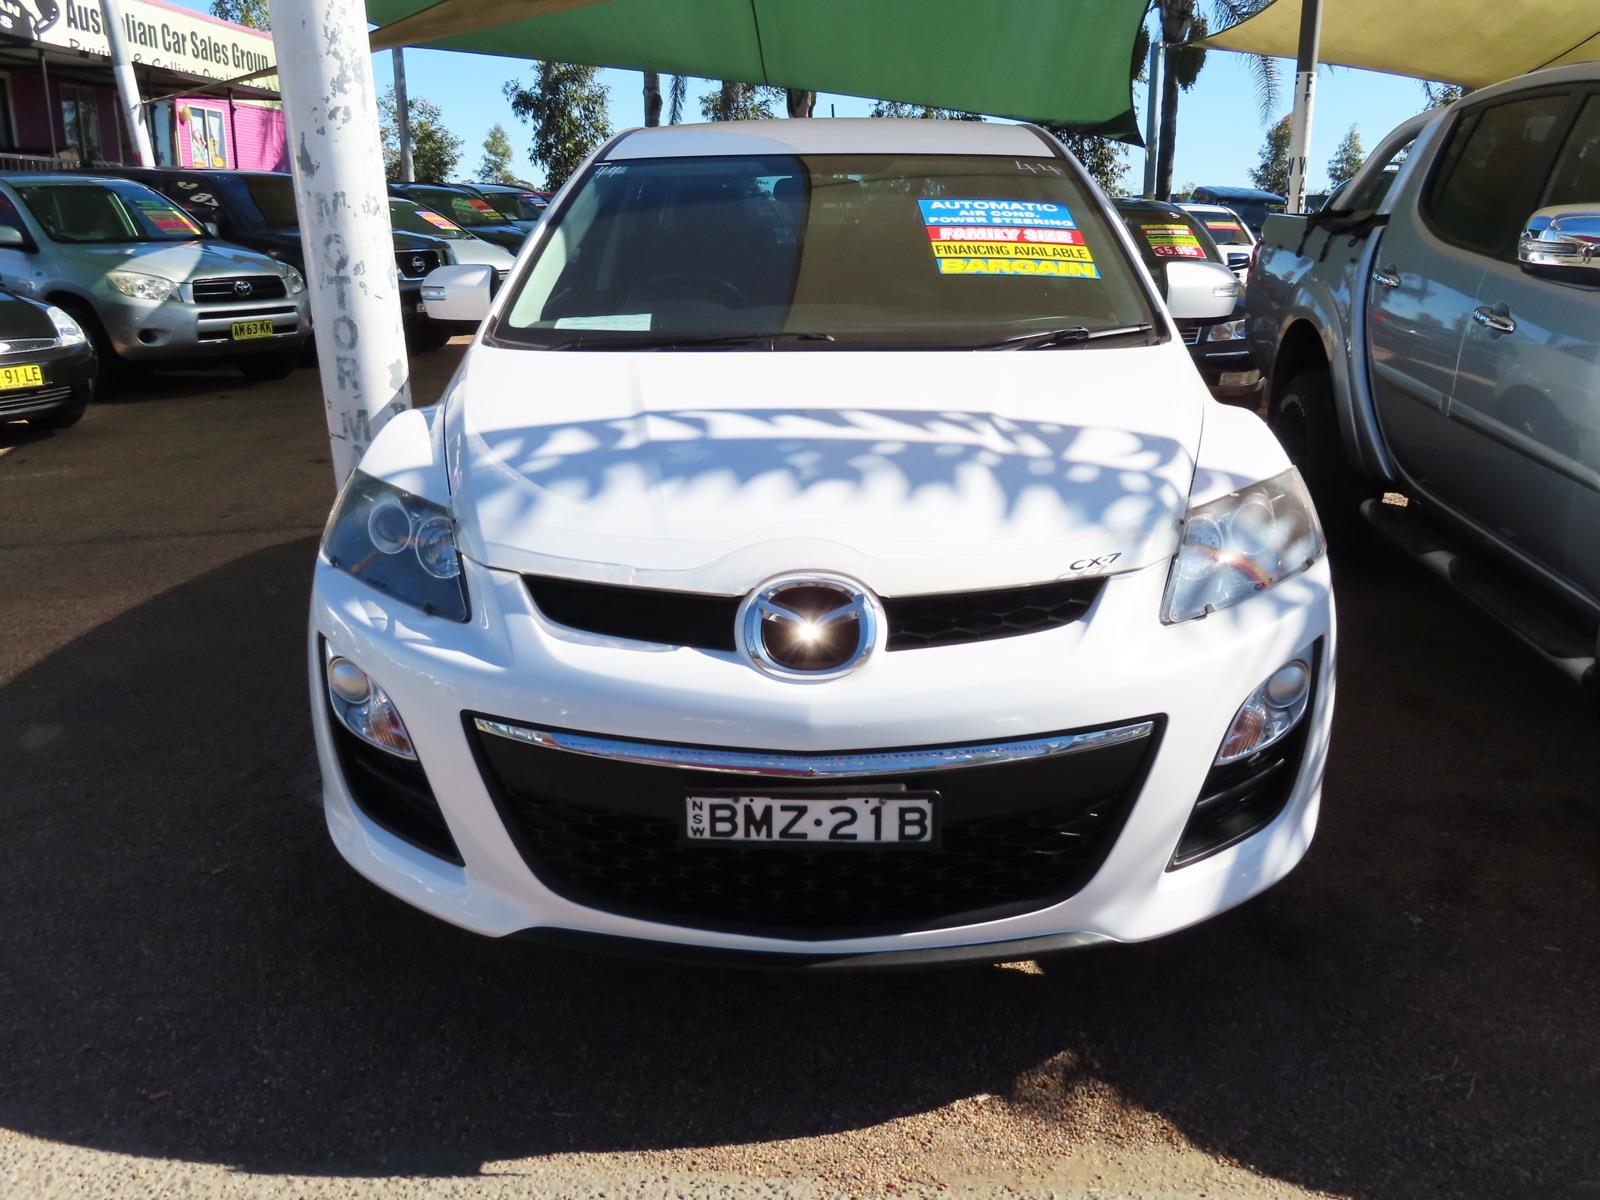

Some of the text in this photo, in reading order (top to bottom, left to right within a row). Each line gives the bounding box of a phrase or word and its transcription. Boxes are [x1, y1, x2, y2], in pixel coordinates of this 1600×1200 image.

[66, 0, 158, 49] Austlian
[161, 23, 187, 56] Car
[190, 31, 229, 66] Sales
[930, 201, 1059, 212] AUTOMATIC
[996, 217, 1074, 227] STEERING
[939, 228, 1074, 244] FAMILY SIZE
[935, 244, 1088, 260] FINANCING AVAILABLE
[940, 258, 1097, 278] BARGAIN
[1069, 552, 1122, 570] CX-7
[691, 800, 706, 837] NSW
